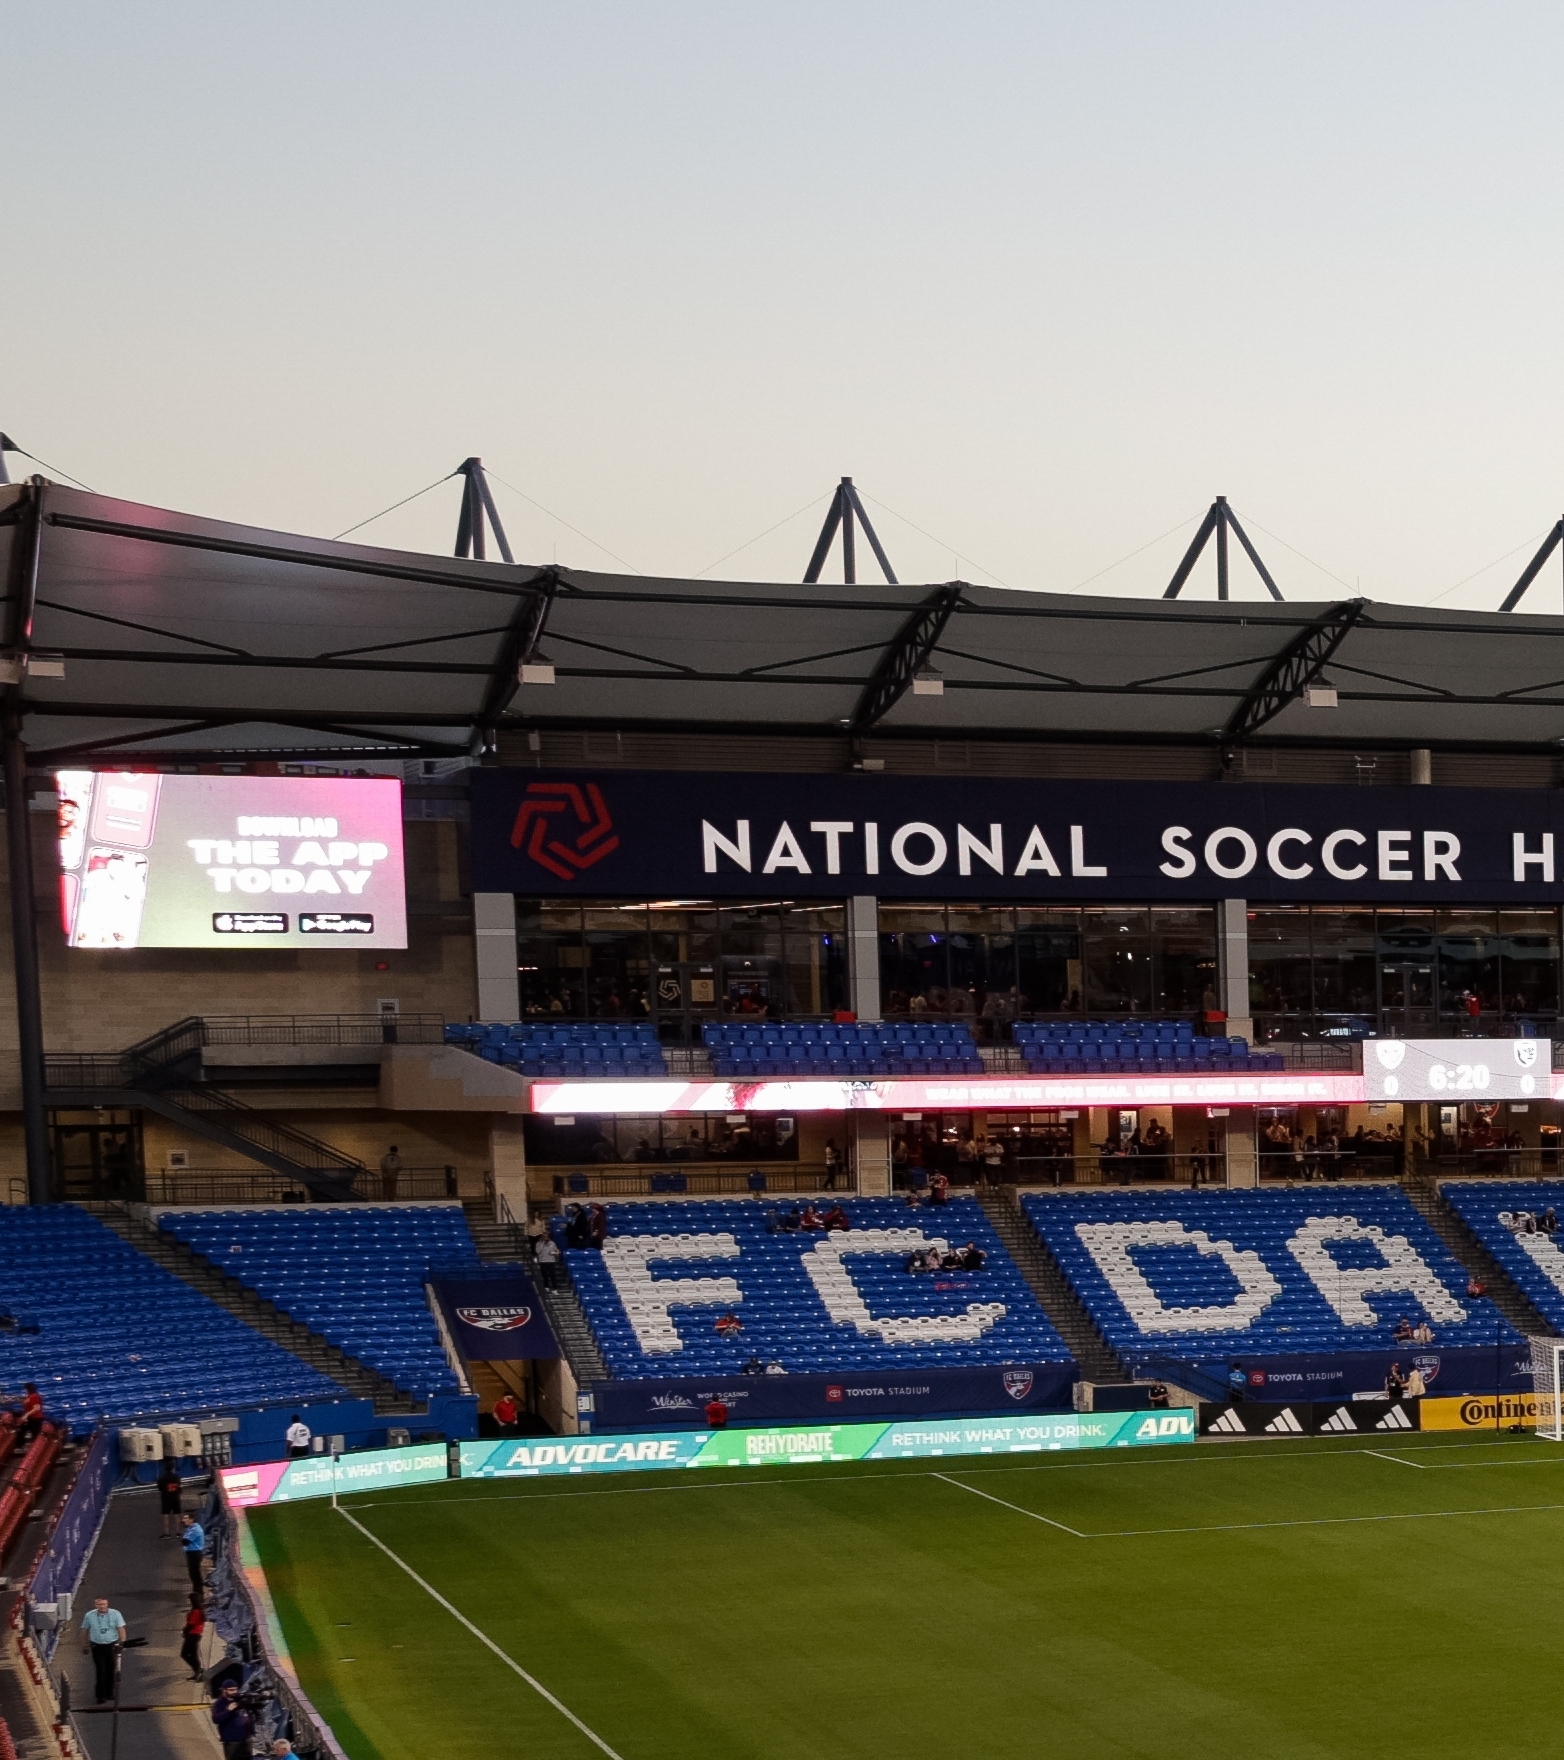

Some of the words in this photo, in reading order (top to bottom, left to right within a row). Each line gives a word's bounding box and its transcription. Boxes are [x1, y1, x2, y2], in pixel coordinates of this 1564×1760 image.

[187, 839, 280, 865] THE
[291, 841, 388, 866] APP
[702, 819, 1107, 877] NATIONAL
[1159, 825, 1462, 882] SOCCER
[207, 868, 371, 894] TODAY
[1429, 1064, 1490, 1090] 6:20
[601, 1227, 1007, 1355] FC
[482, 1308, 525, 1316] DALLAS
[1268, 1373, 1303, 1382] TOYOTA
[1306, 1371, 1343, 1381] STADIUM
[846, 1388, 885, 1396] TOYOTA
[888, 1386, 930, 1396] STADIUM
[746, 1432, 833, 1455] REHYDRATE
[892, 1431, 961, 1446] RETHINK
[965, 1428, 1013, 1443] WHAT
[1017, 1427, 1050, 1440] YOU
[1054, 1424, 1106, 1438] DRINK.
[506, 1440, 681, 1467] ADVOCARE
[290, 1467, 344, 1486] RETHINK
[348, 1462, 384, 1479] WHAT
[387, 1459, 412, 1474] YOU
